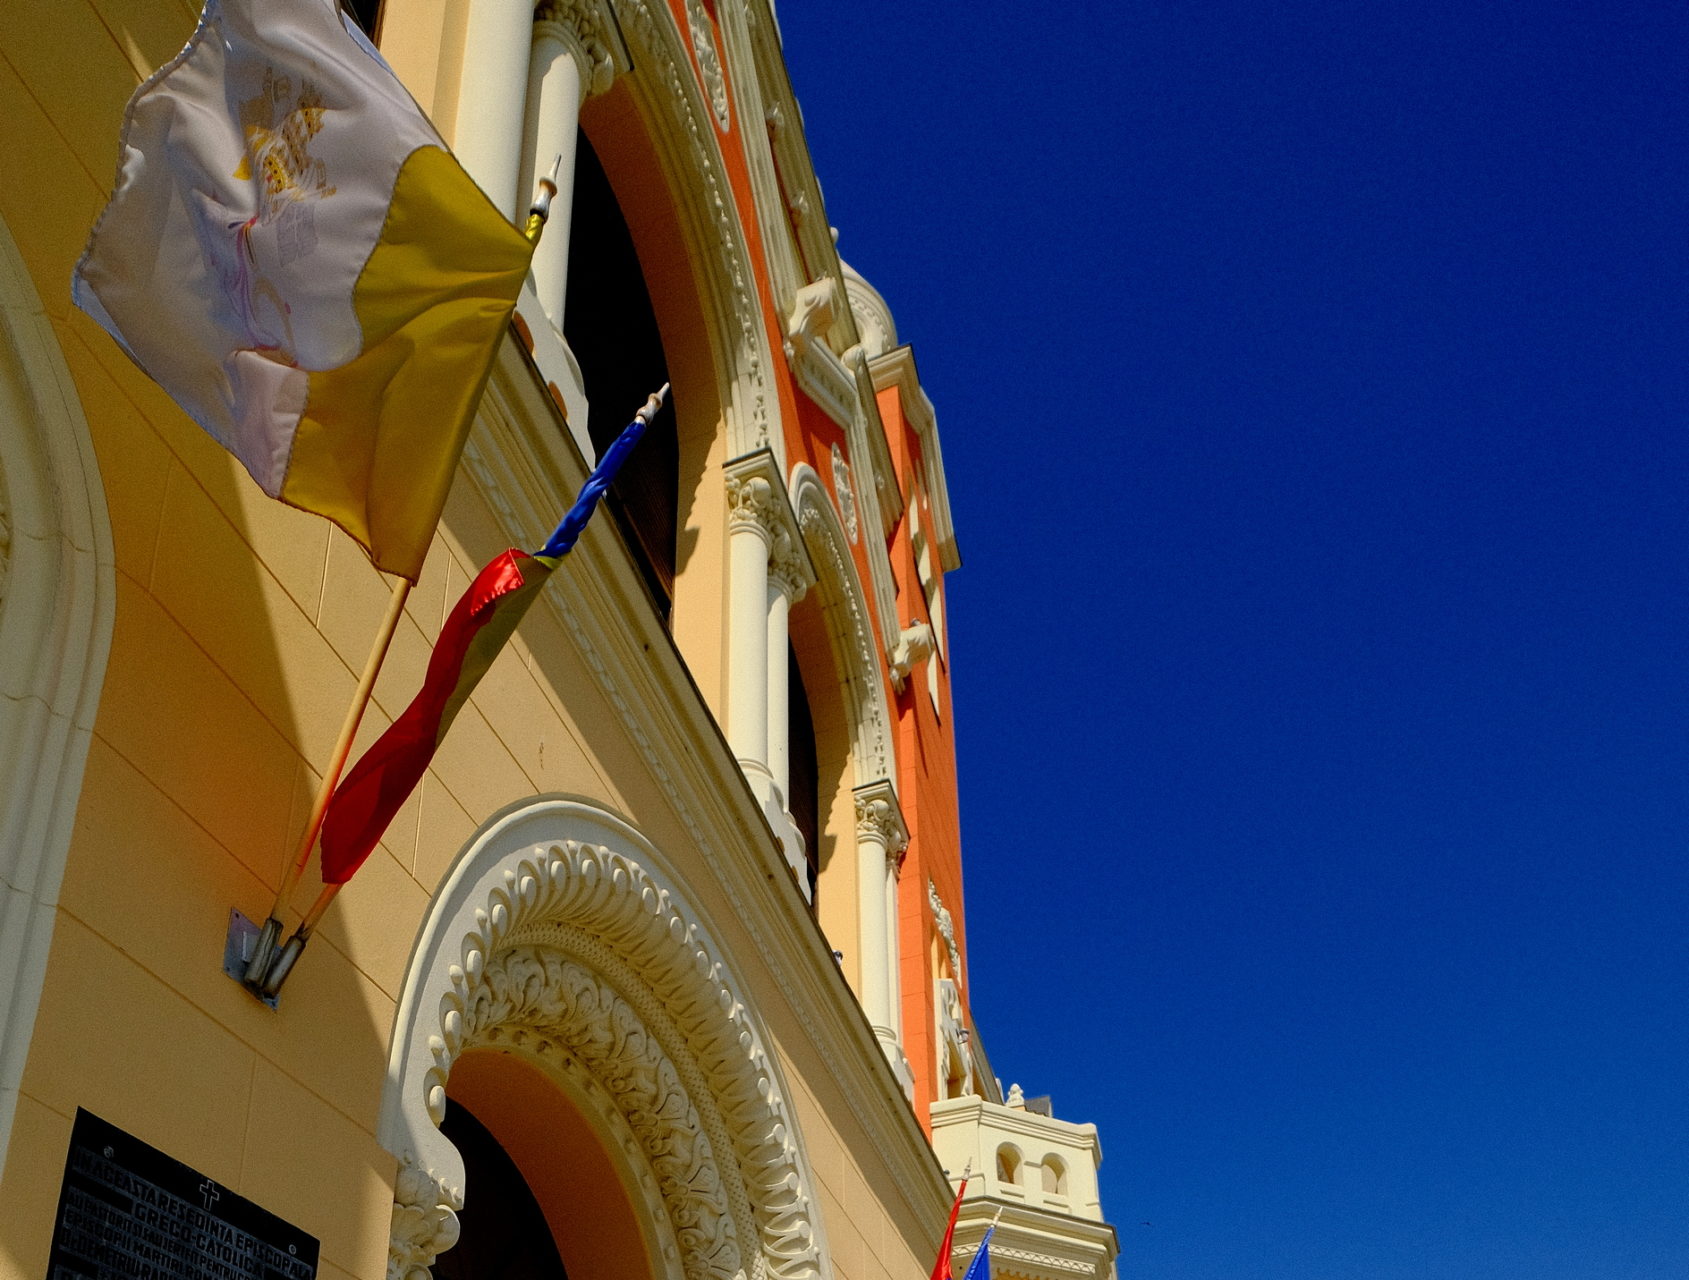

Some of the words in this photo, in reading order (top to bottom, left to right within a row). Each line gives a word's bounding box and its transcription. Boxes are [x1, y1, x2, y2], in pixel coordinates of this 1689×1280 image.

[91, 1158, 157, 1205] ACEASTA
[157, 1192, 233, 1244] RESEDINTA
[134, 1201, 262, 1278] GRECO-CATOLICA
[64, 1208, 130, 1250] EPISCOPII
[133, 1240, 183, 1274] MARTIRI
